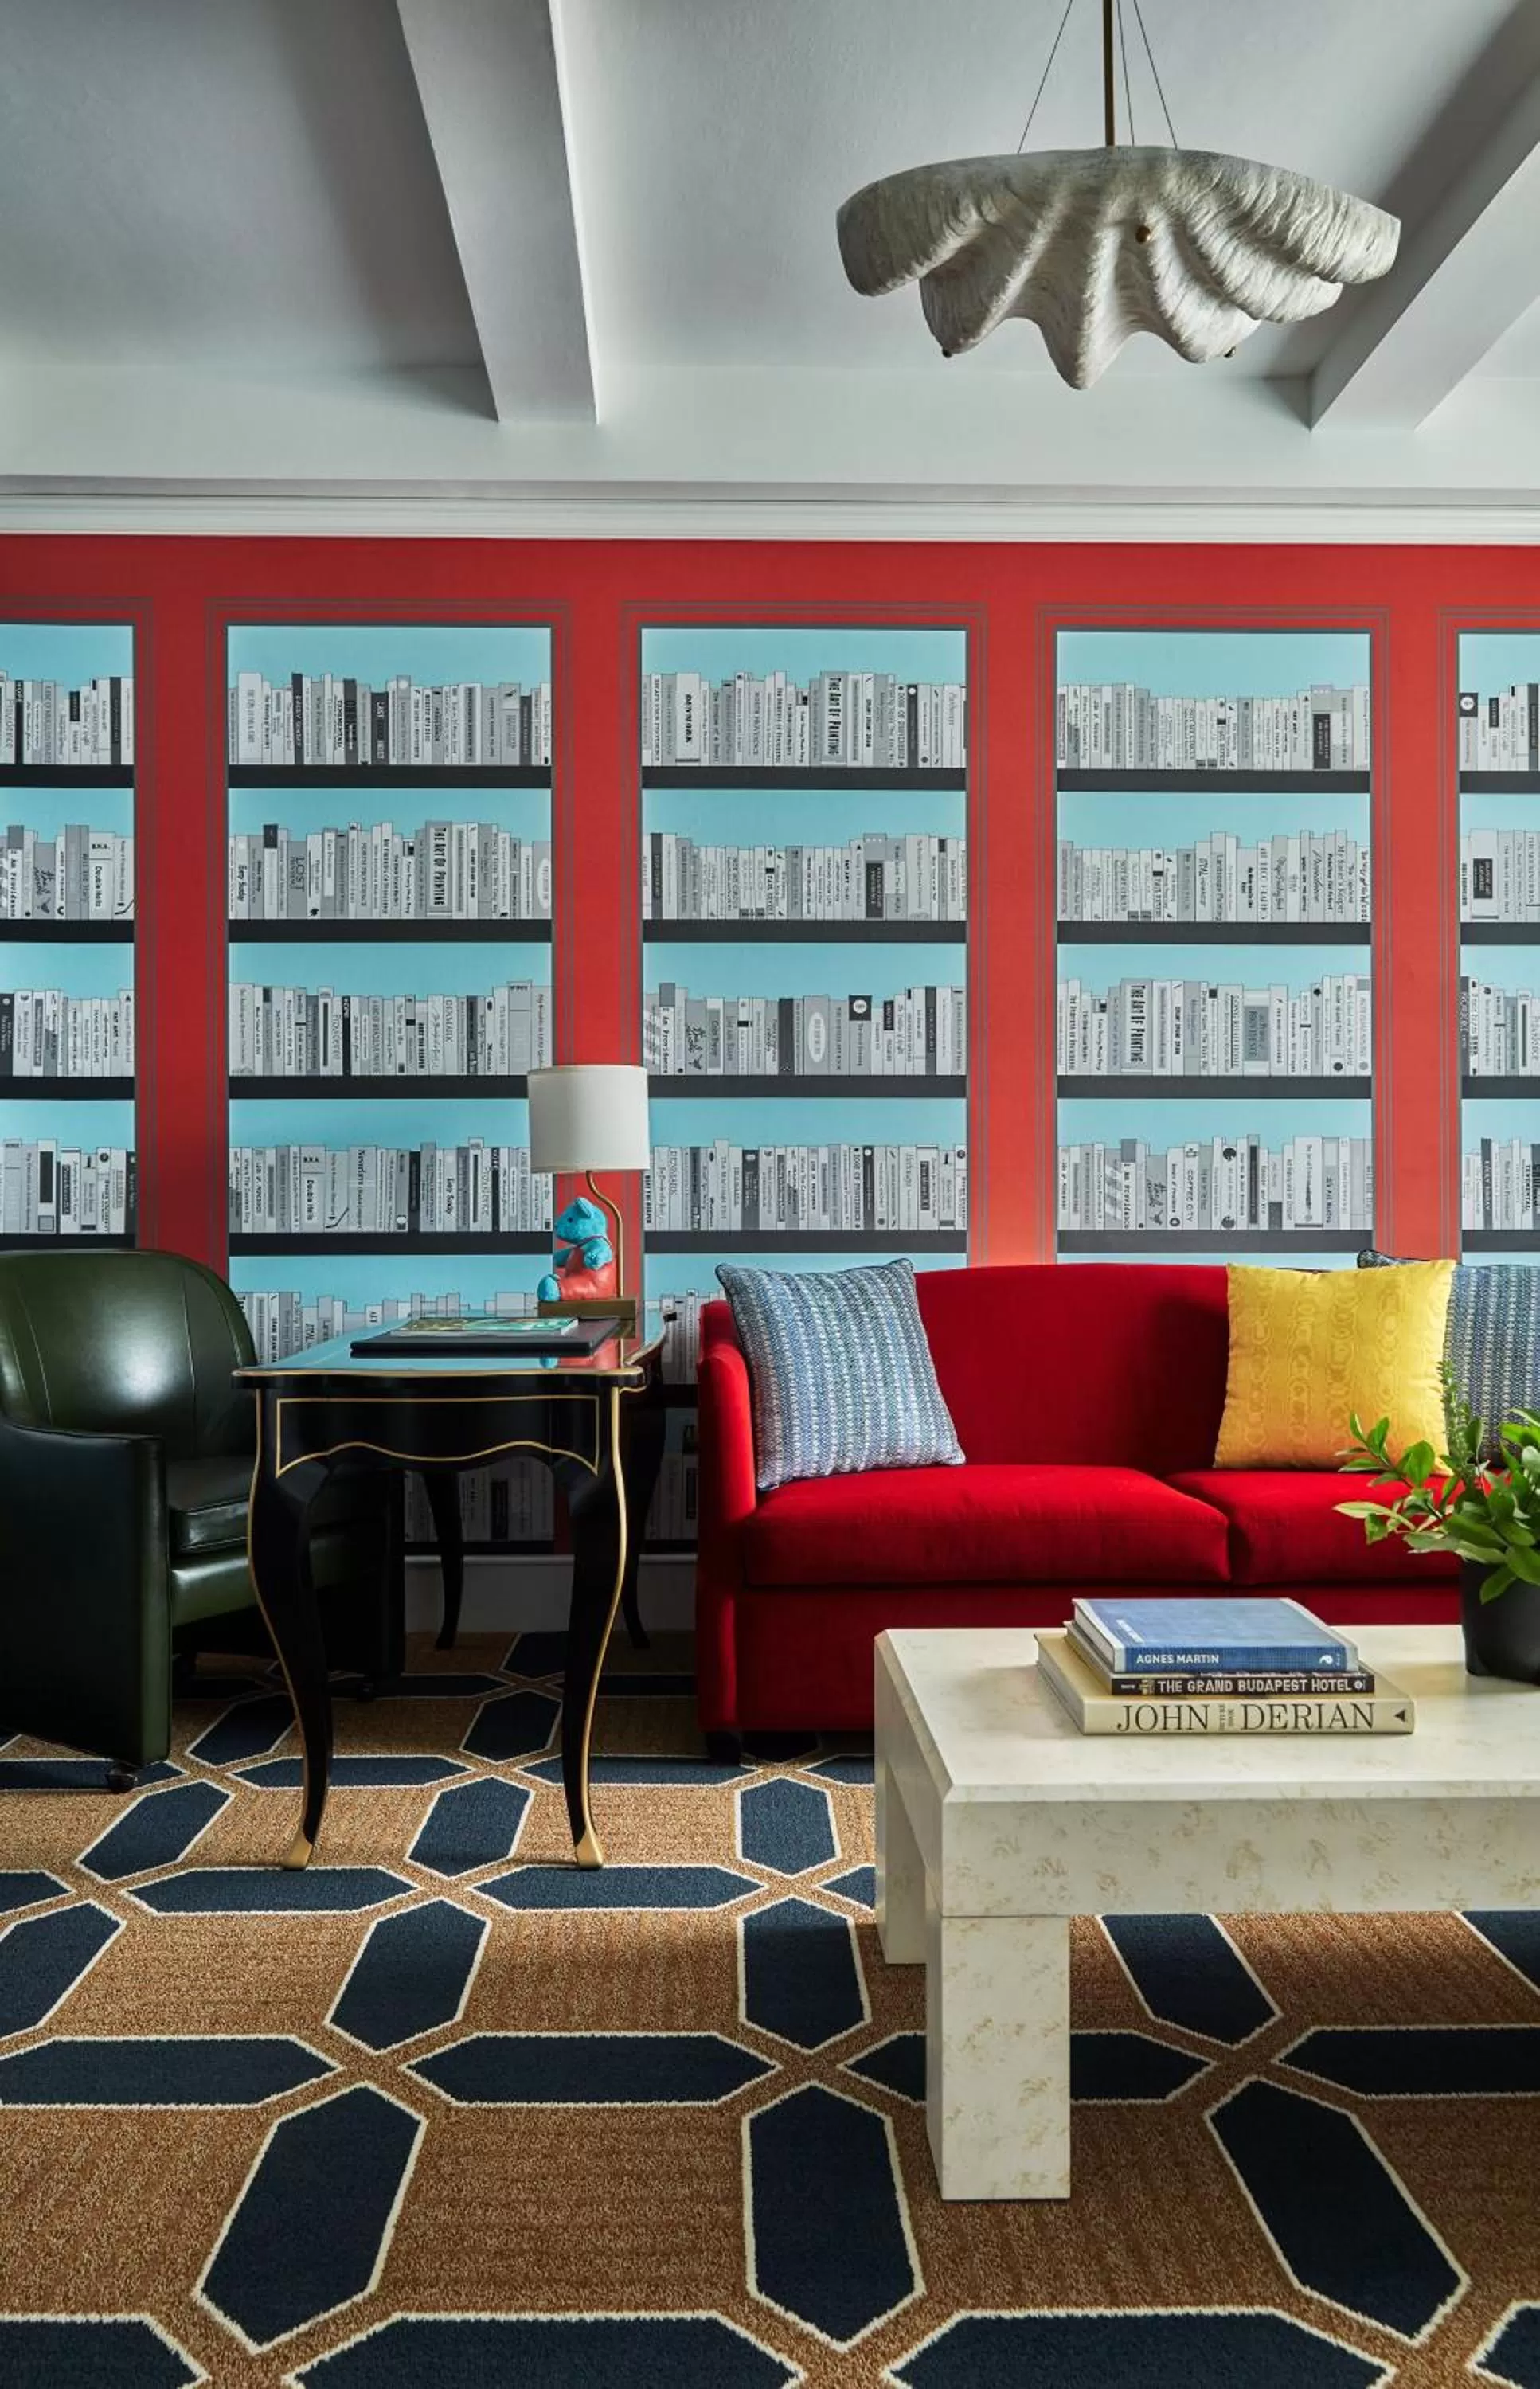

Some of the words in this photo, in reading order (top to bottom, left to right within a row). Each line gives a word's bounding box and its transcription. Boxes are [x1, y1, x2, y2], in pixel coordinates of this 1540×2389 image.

[1136, 1654, 1175, 1664] AGNES
[1176, 1654, 1220, 1664] MARTIN
[1157, 1680, 1183, 1693] THE
[1187, 1679, 1233, 1693] GRAND
[1238, 1678, 1308, 1692] BUDAPEST
[1311, 1678, 1352, 1691] HOTEL
[1116, 1704, 1210, 1732] JOHN
[1240, 1702, 1376, 1730] DERIAN
